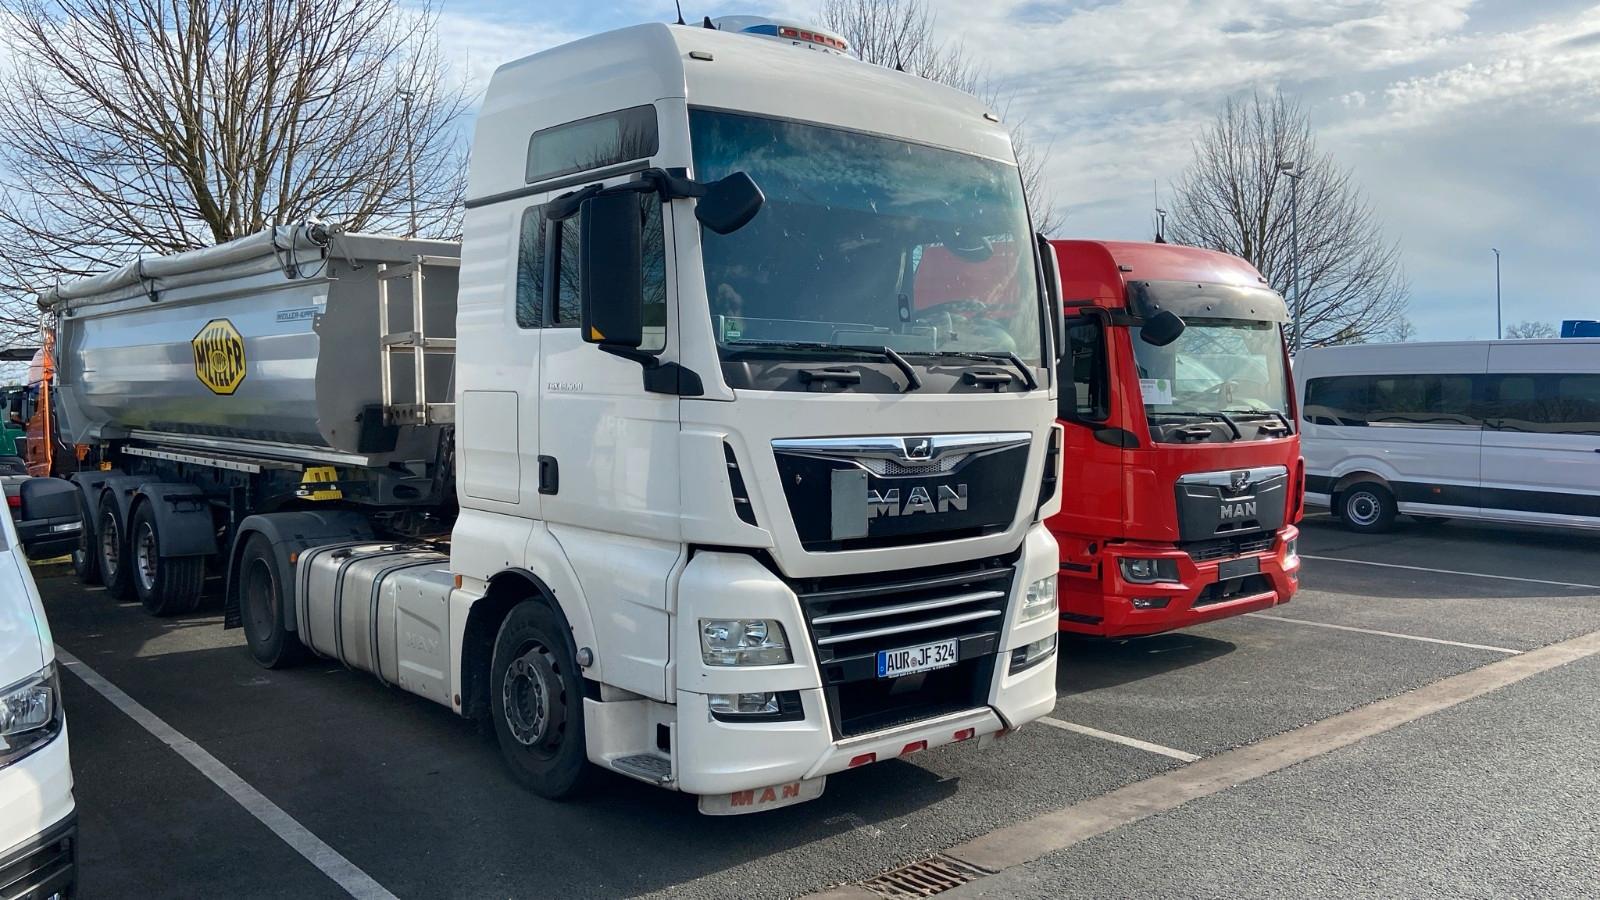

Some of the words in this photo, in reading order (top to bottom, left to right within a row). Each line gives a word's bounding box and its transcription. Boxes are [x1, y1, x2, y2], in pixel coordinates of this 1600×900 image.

[196, 327, 243, 387] MEILLER
[868, 484, 968, 518] MAN
[1220, 501, 1257, 519] MAN
[887, 650, 910, 672] AUR
[917, 647, 932, 666] JF
[934, 643, 955, 663] 324
[731, 783, 800, 807] MAN
